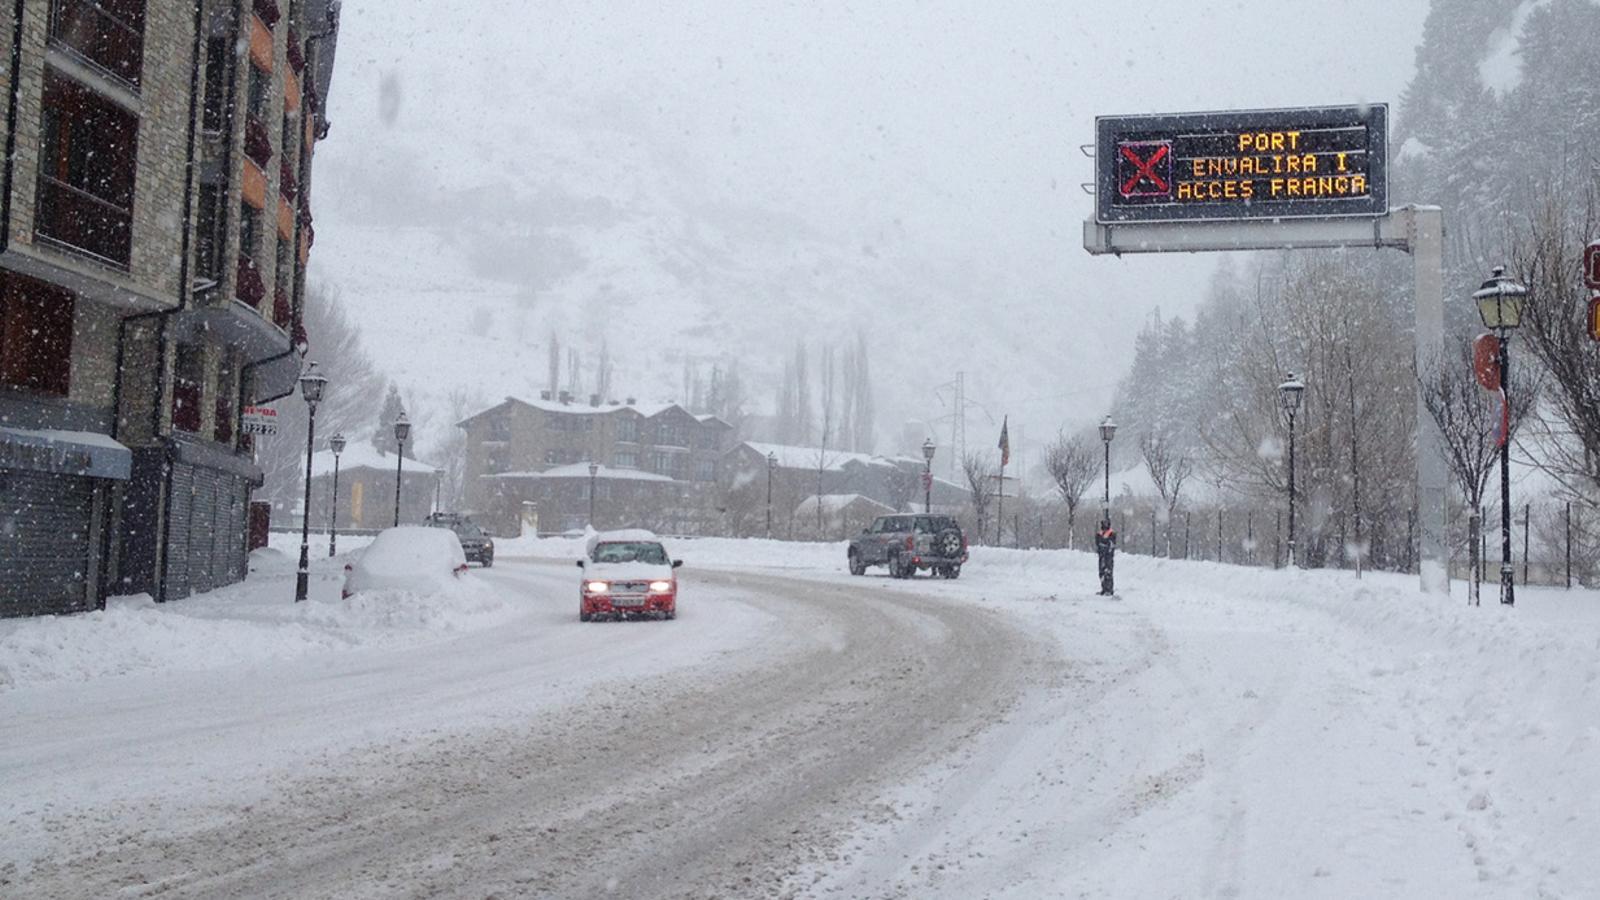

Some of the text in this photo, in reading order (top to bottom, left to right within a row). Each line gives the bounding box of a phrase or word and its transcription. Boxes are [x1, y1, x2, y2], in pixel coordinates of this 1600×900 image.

[1239, 131, 1300, 152] PORT
[1193, 153, 1348, 176] ENVALIRA I
[1178, 180, 1253, 199] ACCES
